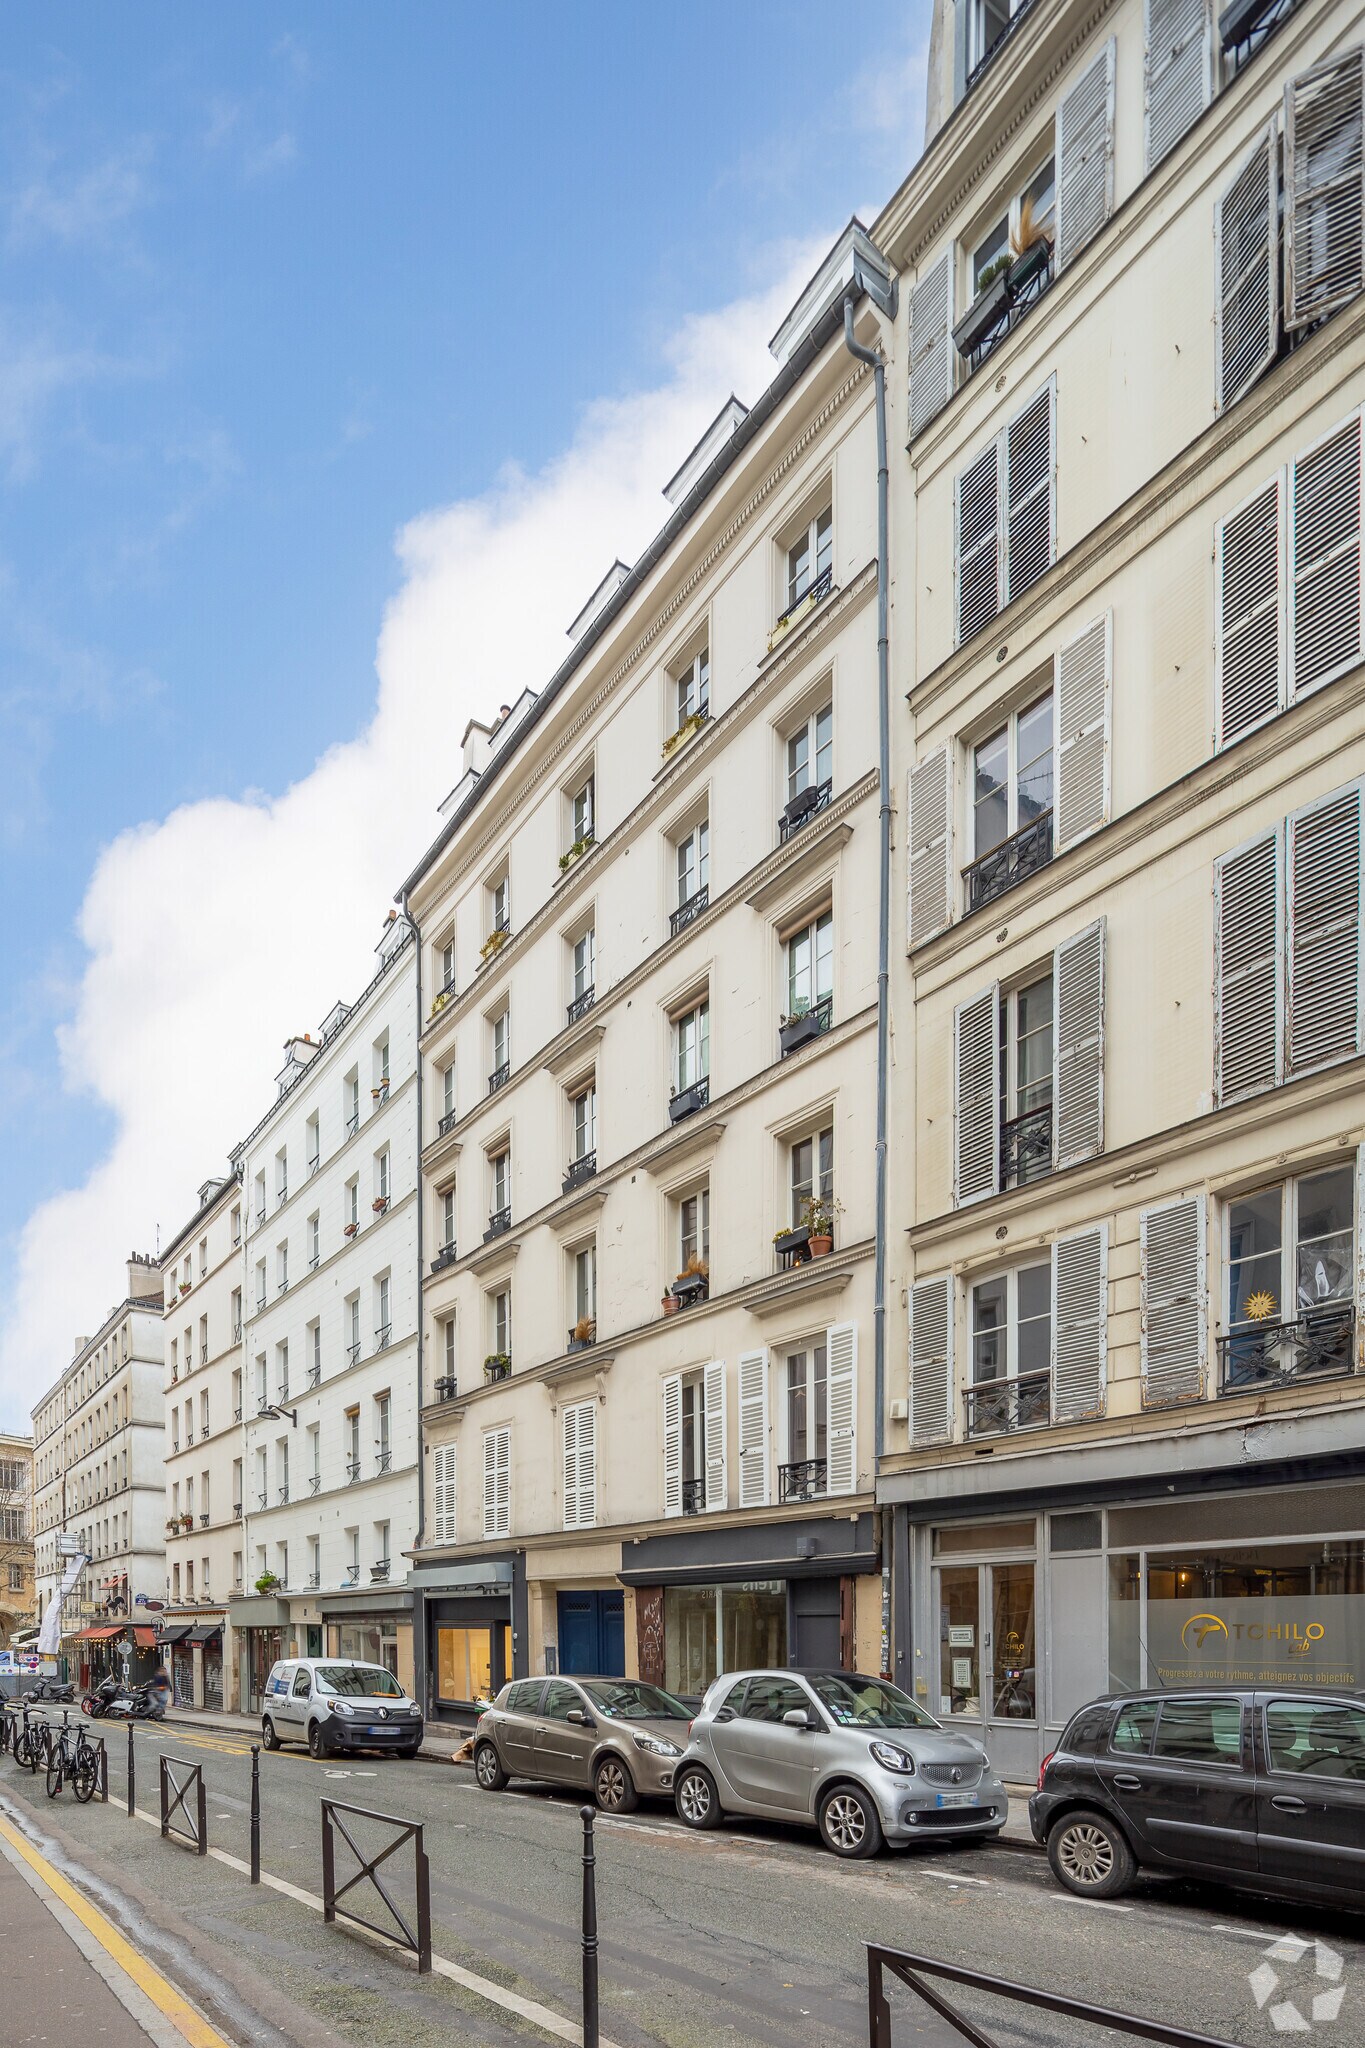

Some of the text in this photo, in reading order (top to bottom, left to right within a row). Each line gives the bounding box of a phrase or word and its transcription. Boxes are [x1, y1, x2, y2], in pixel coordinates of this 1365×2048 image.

[1232, 1623, 1325, 1640] TCHILO
[1158, 1667, 1197, 1679] Progressez
[1206, 1670, 1225, 1679] votre
[1227, 1670, 1256, 1681] rythme,
[1258, 1671, 1297, 1682] atteignez
[1299, 1673, 1313, 1681] vos
[1316, 1672, 1355, 1684] objectifs
